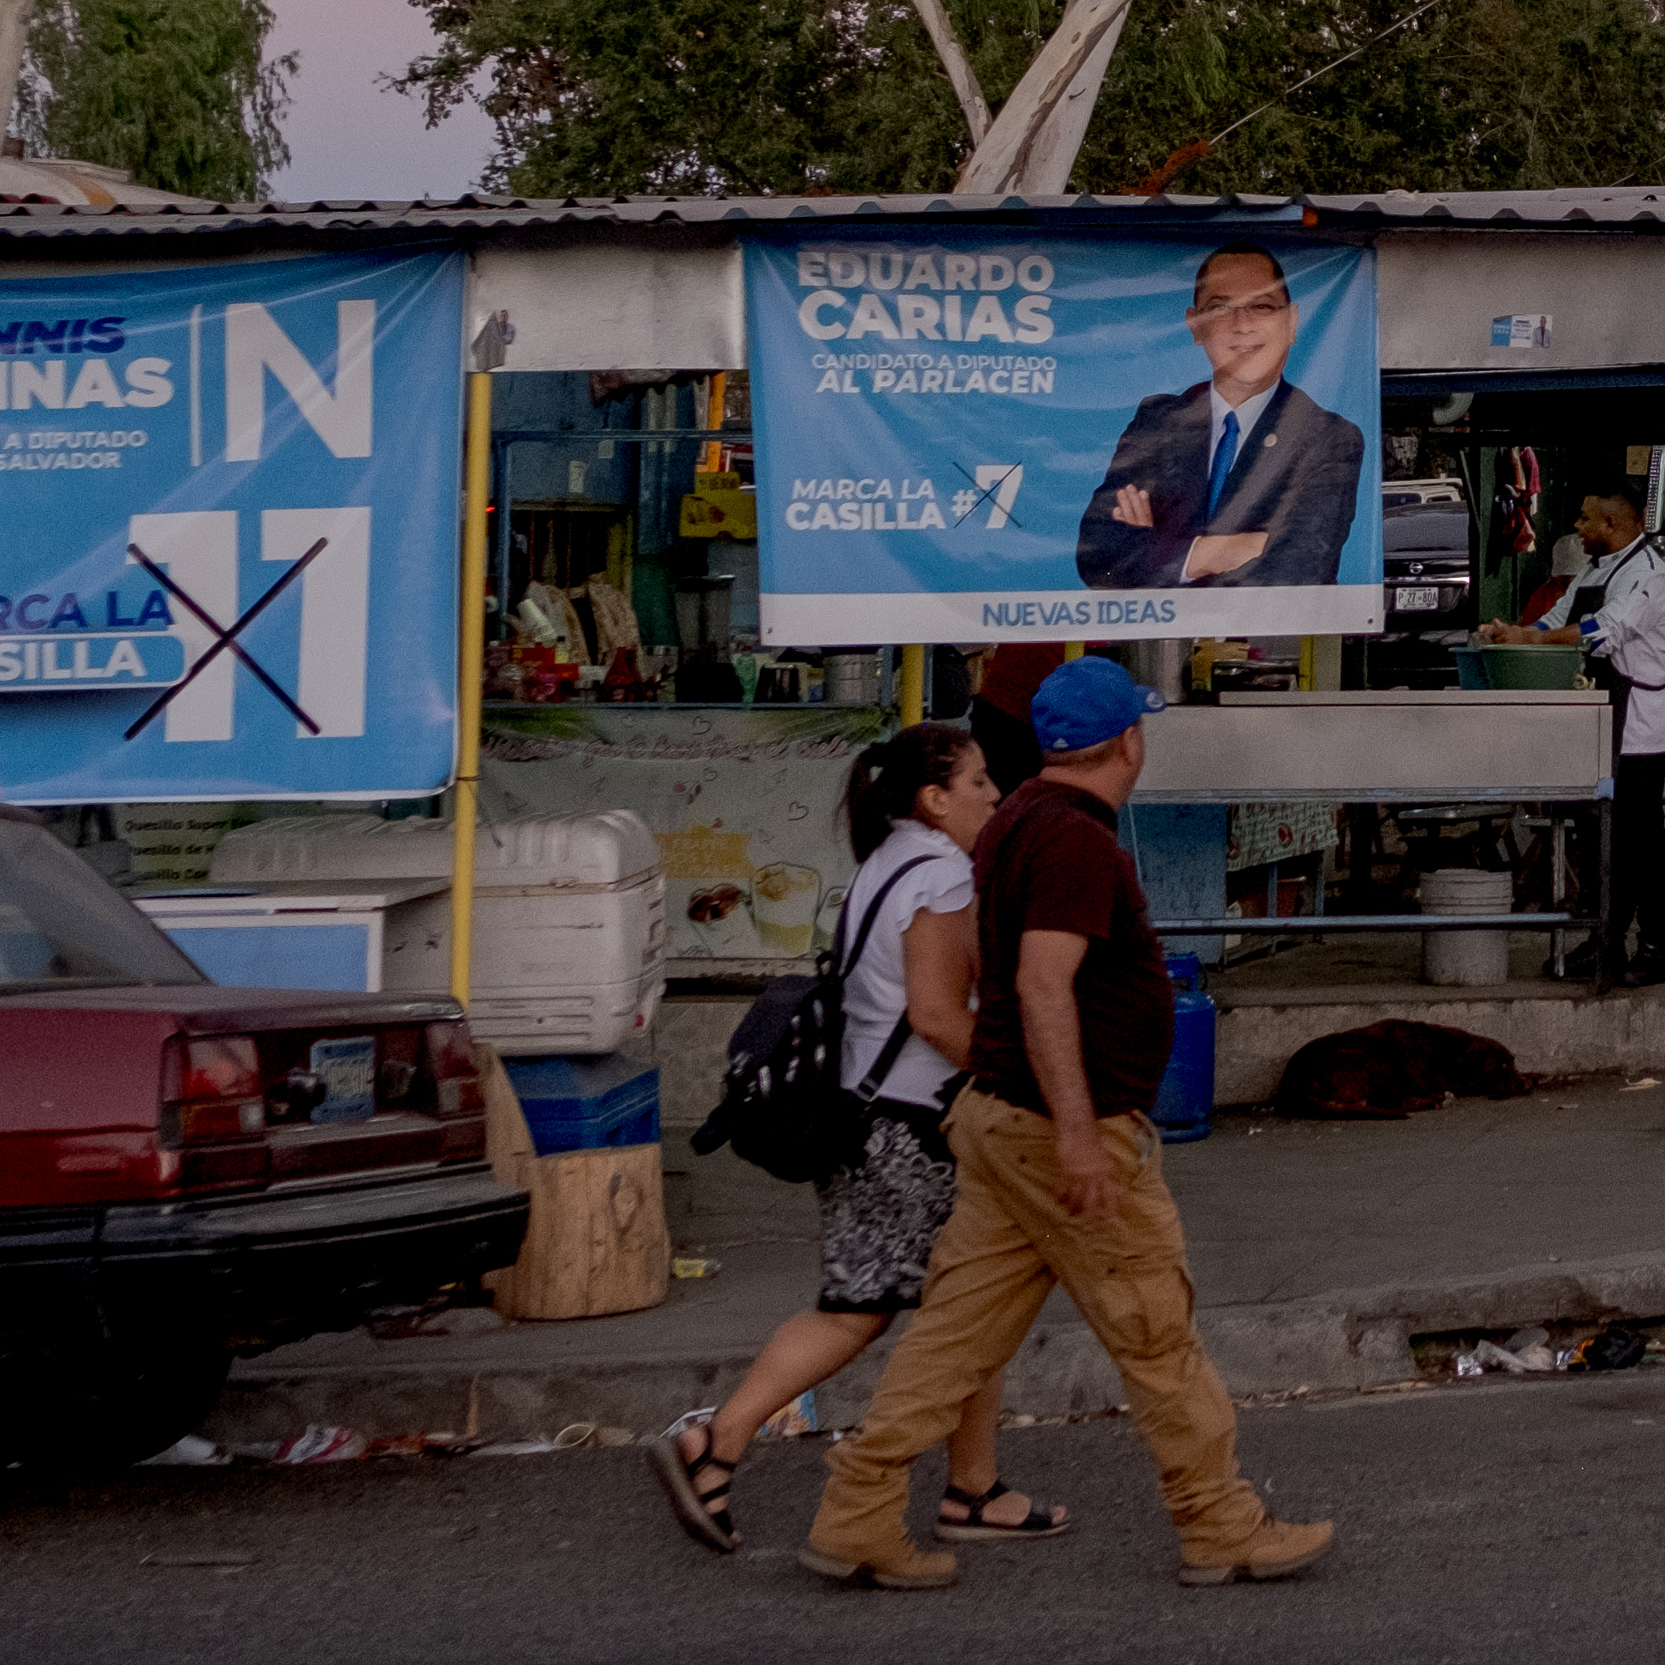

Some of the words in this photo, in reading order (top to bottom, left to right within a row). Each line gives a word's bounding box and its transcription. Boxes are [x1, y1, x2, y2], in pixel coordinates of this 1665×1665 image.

[798, 252, 1054, 293] EDUARDO
[799, 290, 1055, 344] CARIAS
[811, 353, 933, 371] CANDIDATO
[938, 355, 953, 370] A
[956, 354, 1057, 372] DIPUTADO
[225, 299, 376, 462] N
[816, 372, 865, 394] AL
[873, 370, 1055, 395] PARLACEN
[3, 432, 23, 450] A
[28, 429, 150, 450] DIPUTADO
[792, 479, 895, 500] MARCA
[902, 479, 935, 500] LA
[785, 502, 946, 531] CASILLA
[106, 590, 175, 627] LA
[982, 602, 1090, 627] NUEVAS
[1098, 599, 1177, 625] IDEAS
[132, 844, 181, 856] uesillo
